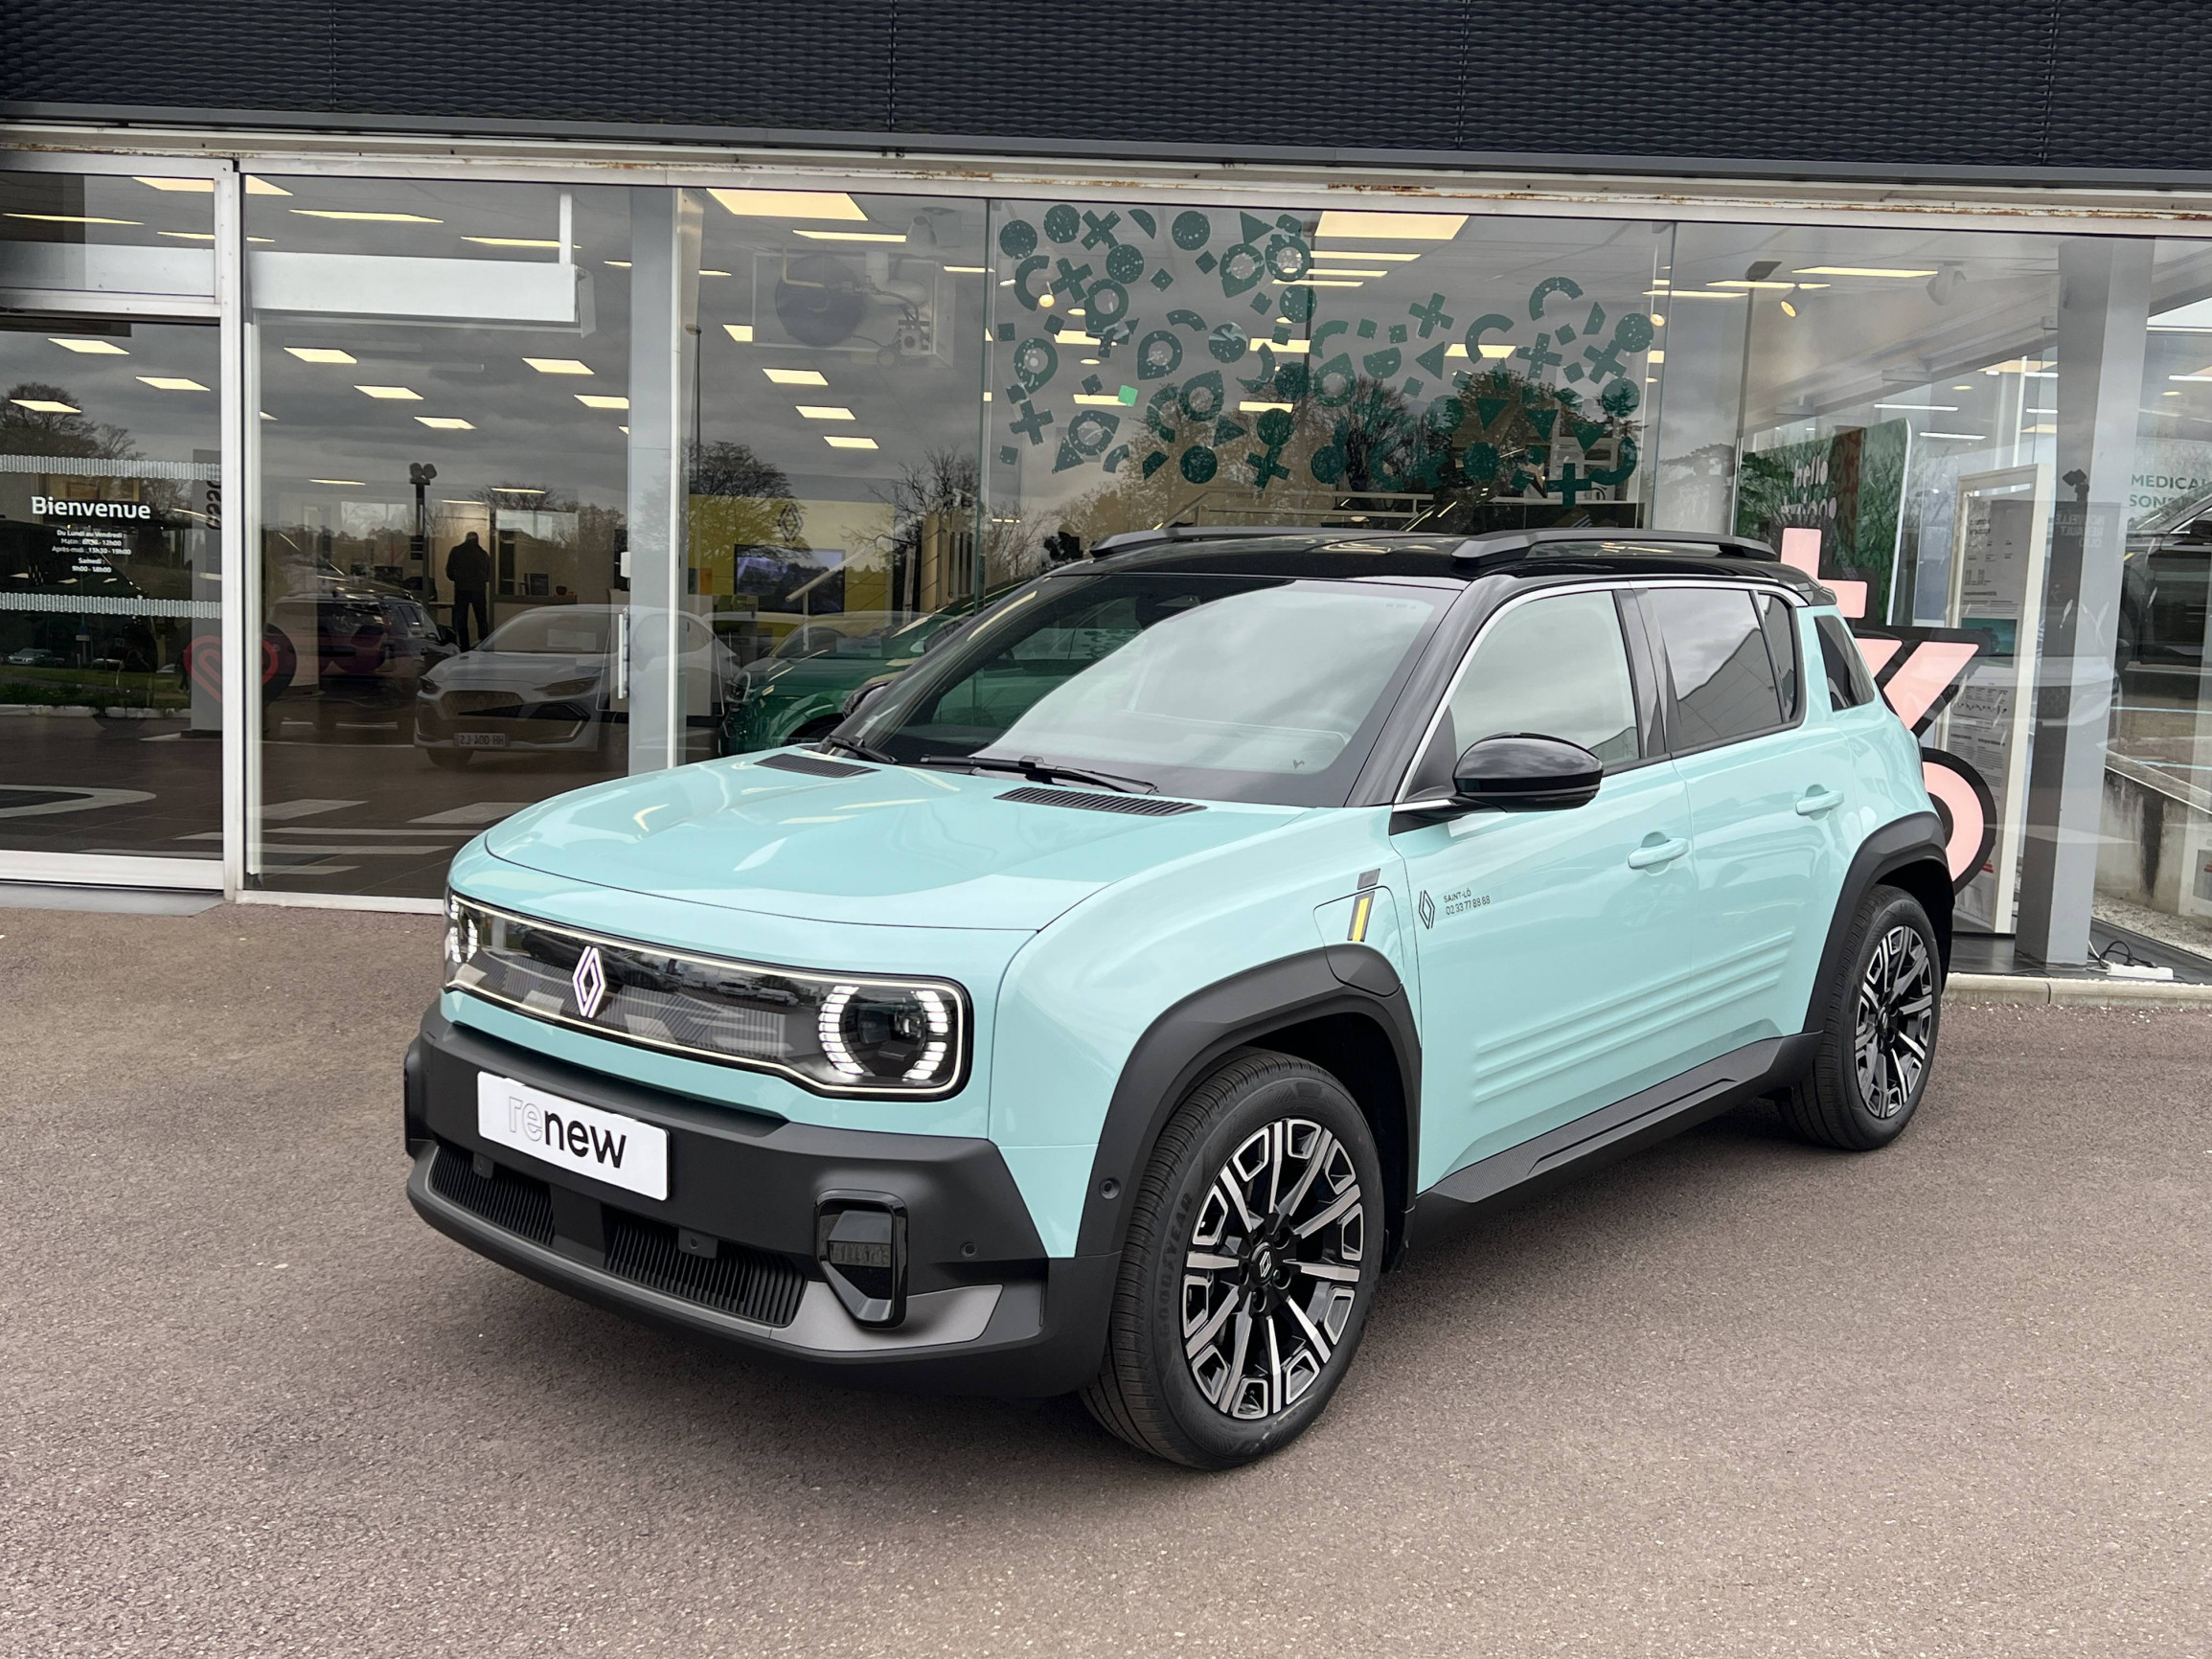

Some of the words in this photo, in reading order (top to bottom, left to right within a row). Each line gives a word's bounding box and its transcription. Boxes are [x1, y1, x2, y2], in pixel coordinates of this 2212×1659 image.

[32, 496, 151, 519] Bienvenue
[2129, 494, 2175, 509] SON
[1446, 904, 1455, 916] 02
[1455, 902, 1464, 913] 33
[1464, 899, 1472, 910] 77
[509, 1096, 627, 1169] renew
[1158, 1193, 1193, 1336] GOODYEAR
